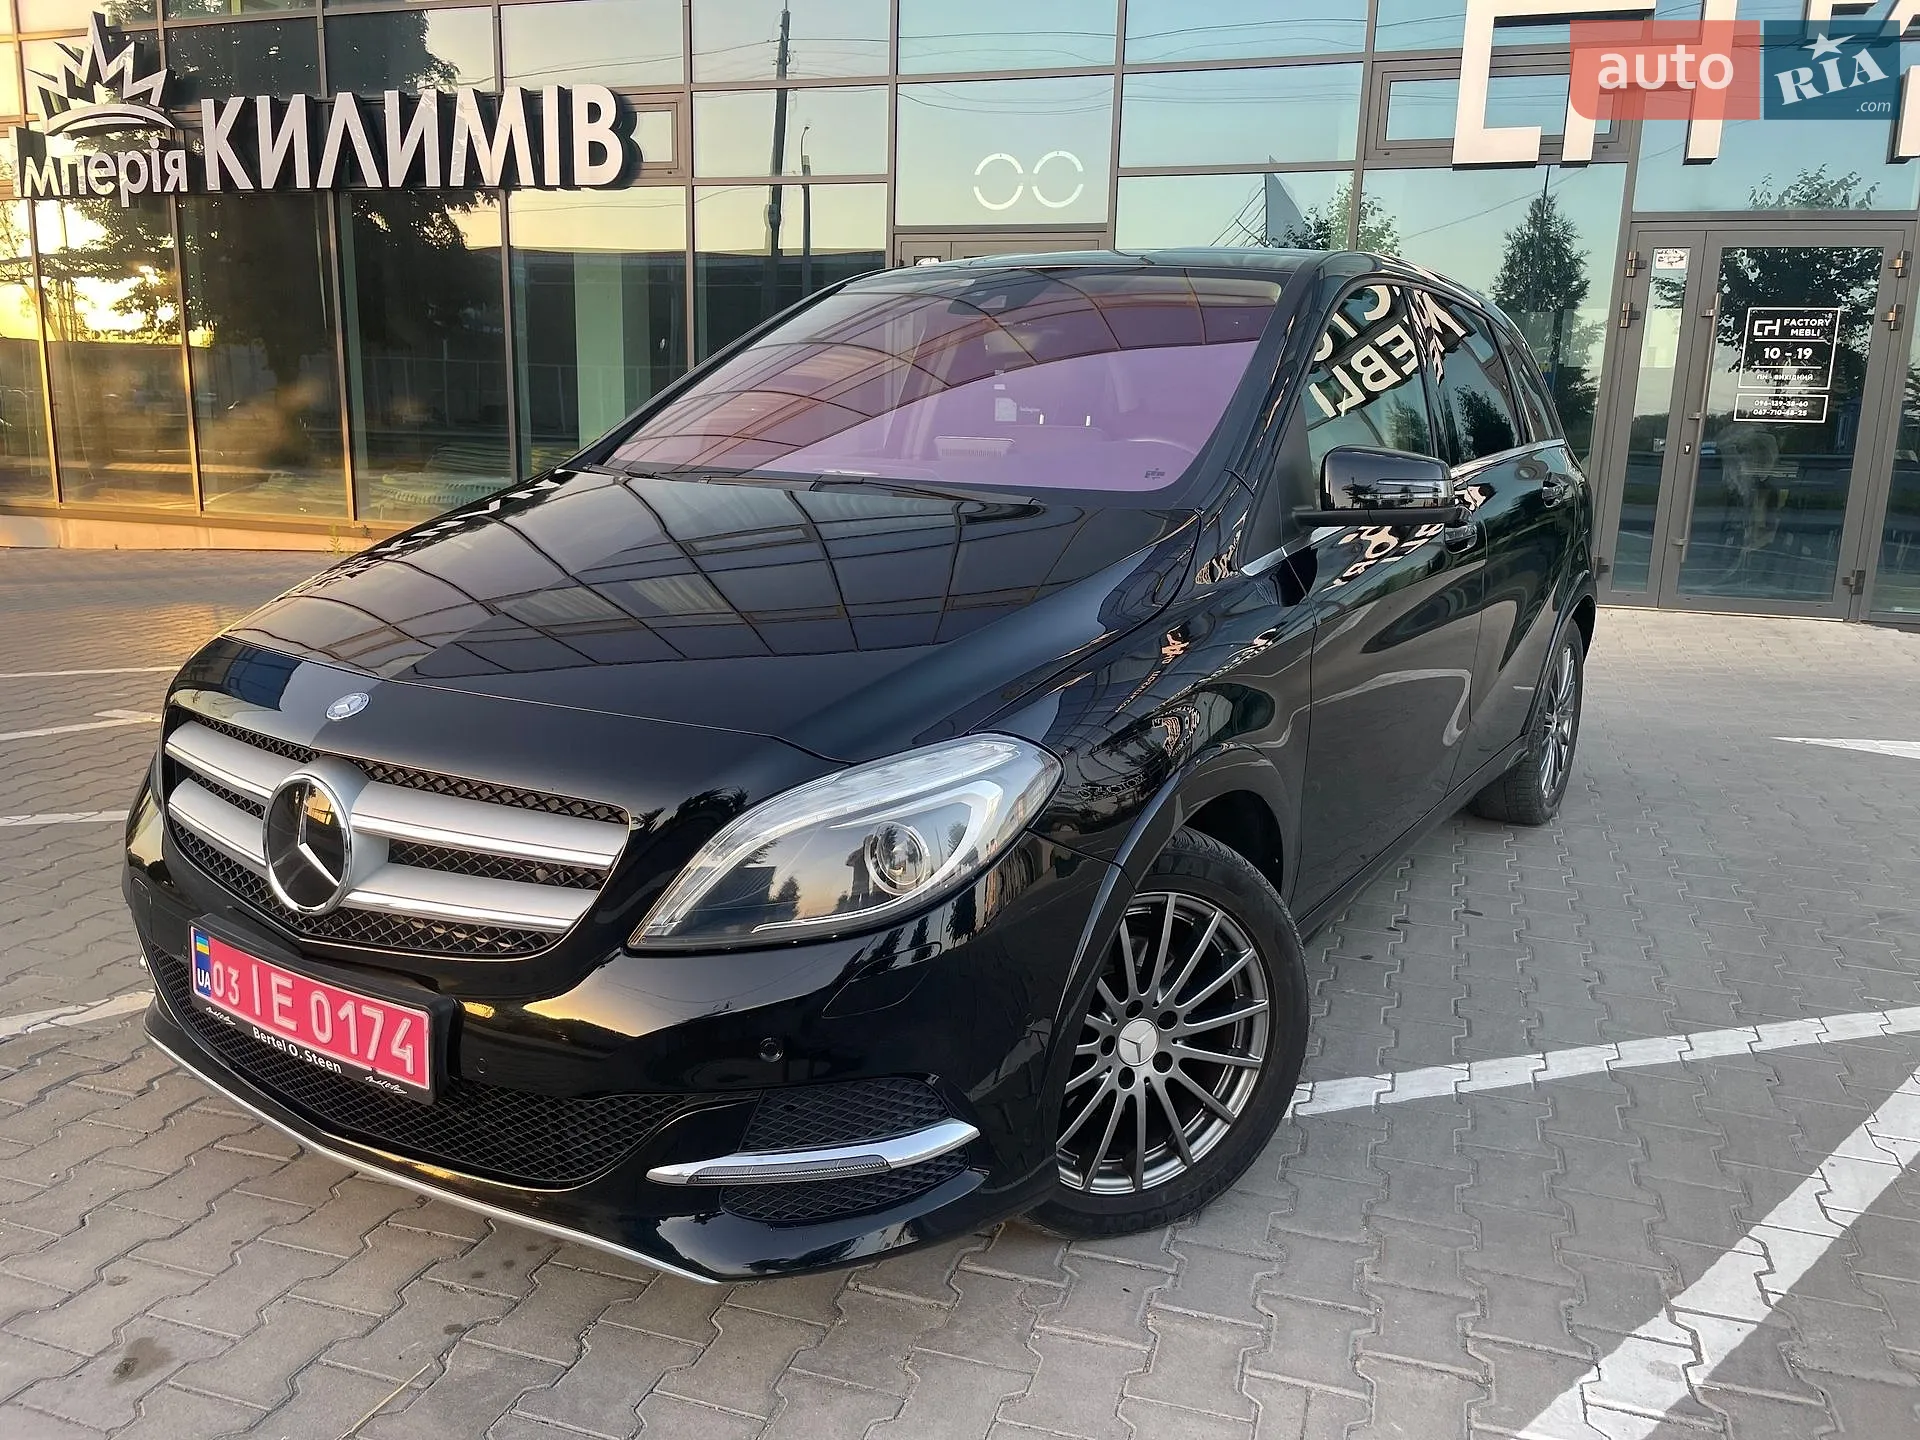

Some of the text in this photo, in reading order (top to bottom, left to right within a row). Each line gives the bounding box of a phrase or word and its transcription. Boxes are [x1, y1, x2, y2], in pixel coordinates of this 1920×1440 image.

[201, 84, 625, 191] КИЛИМІВ
[1783, 318, 1831, 327] FACTORY
[1790, 328, 1820, 337] MEBLI
[1763, 347, 1781, 359] 10
[1797, 347, 1813, 360] 19
[197, 967, 211, 990] UA
[212, 961, 414, 1074] 03 IE 0174
[252, 1025, 343, 1074] Bertel O. Steen
